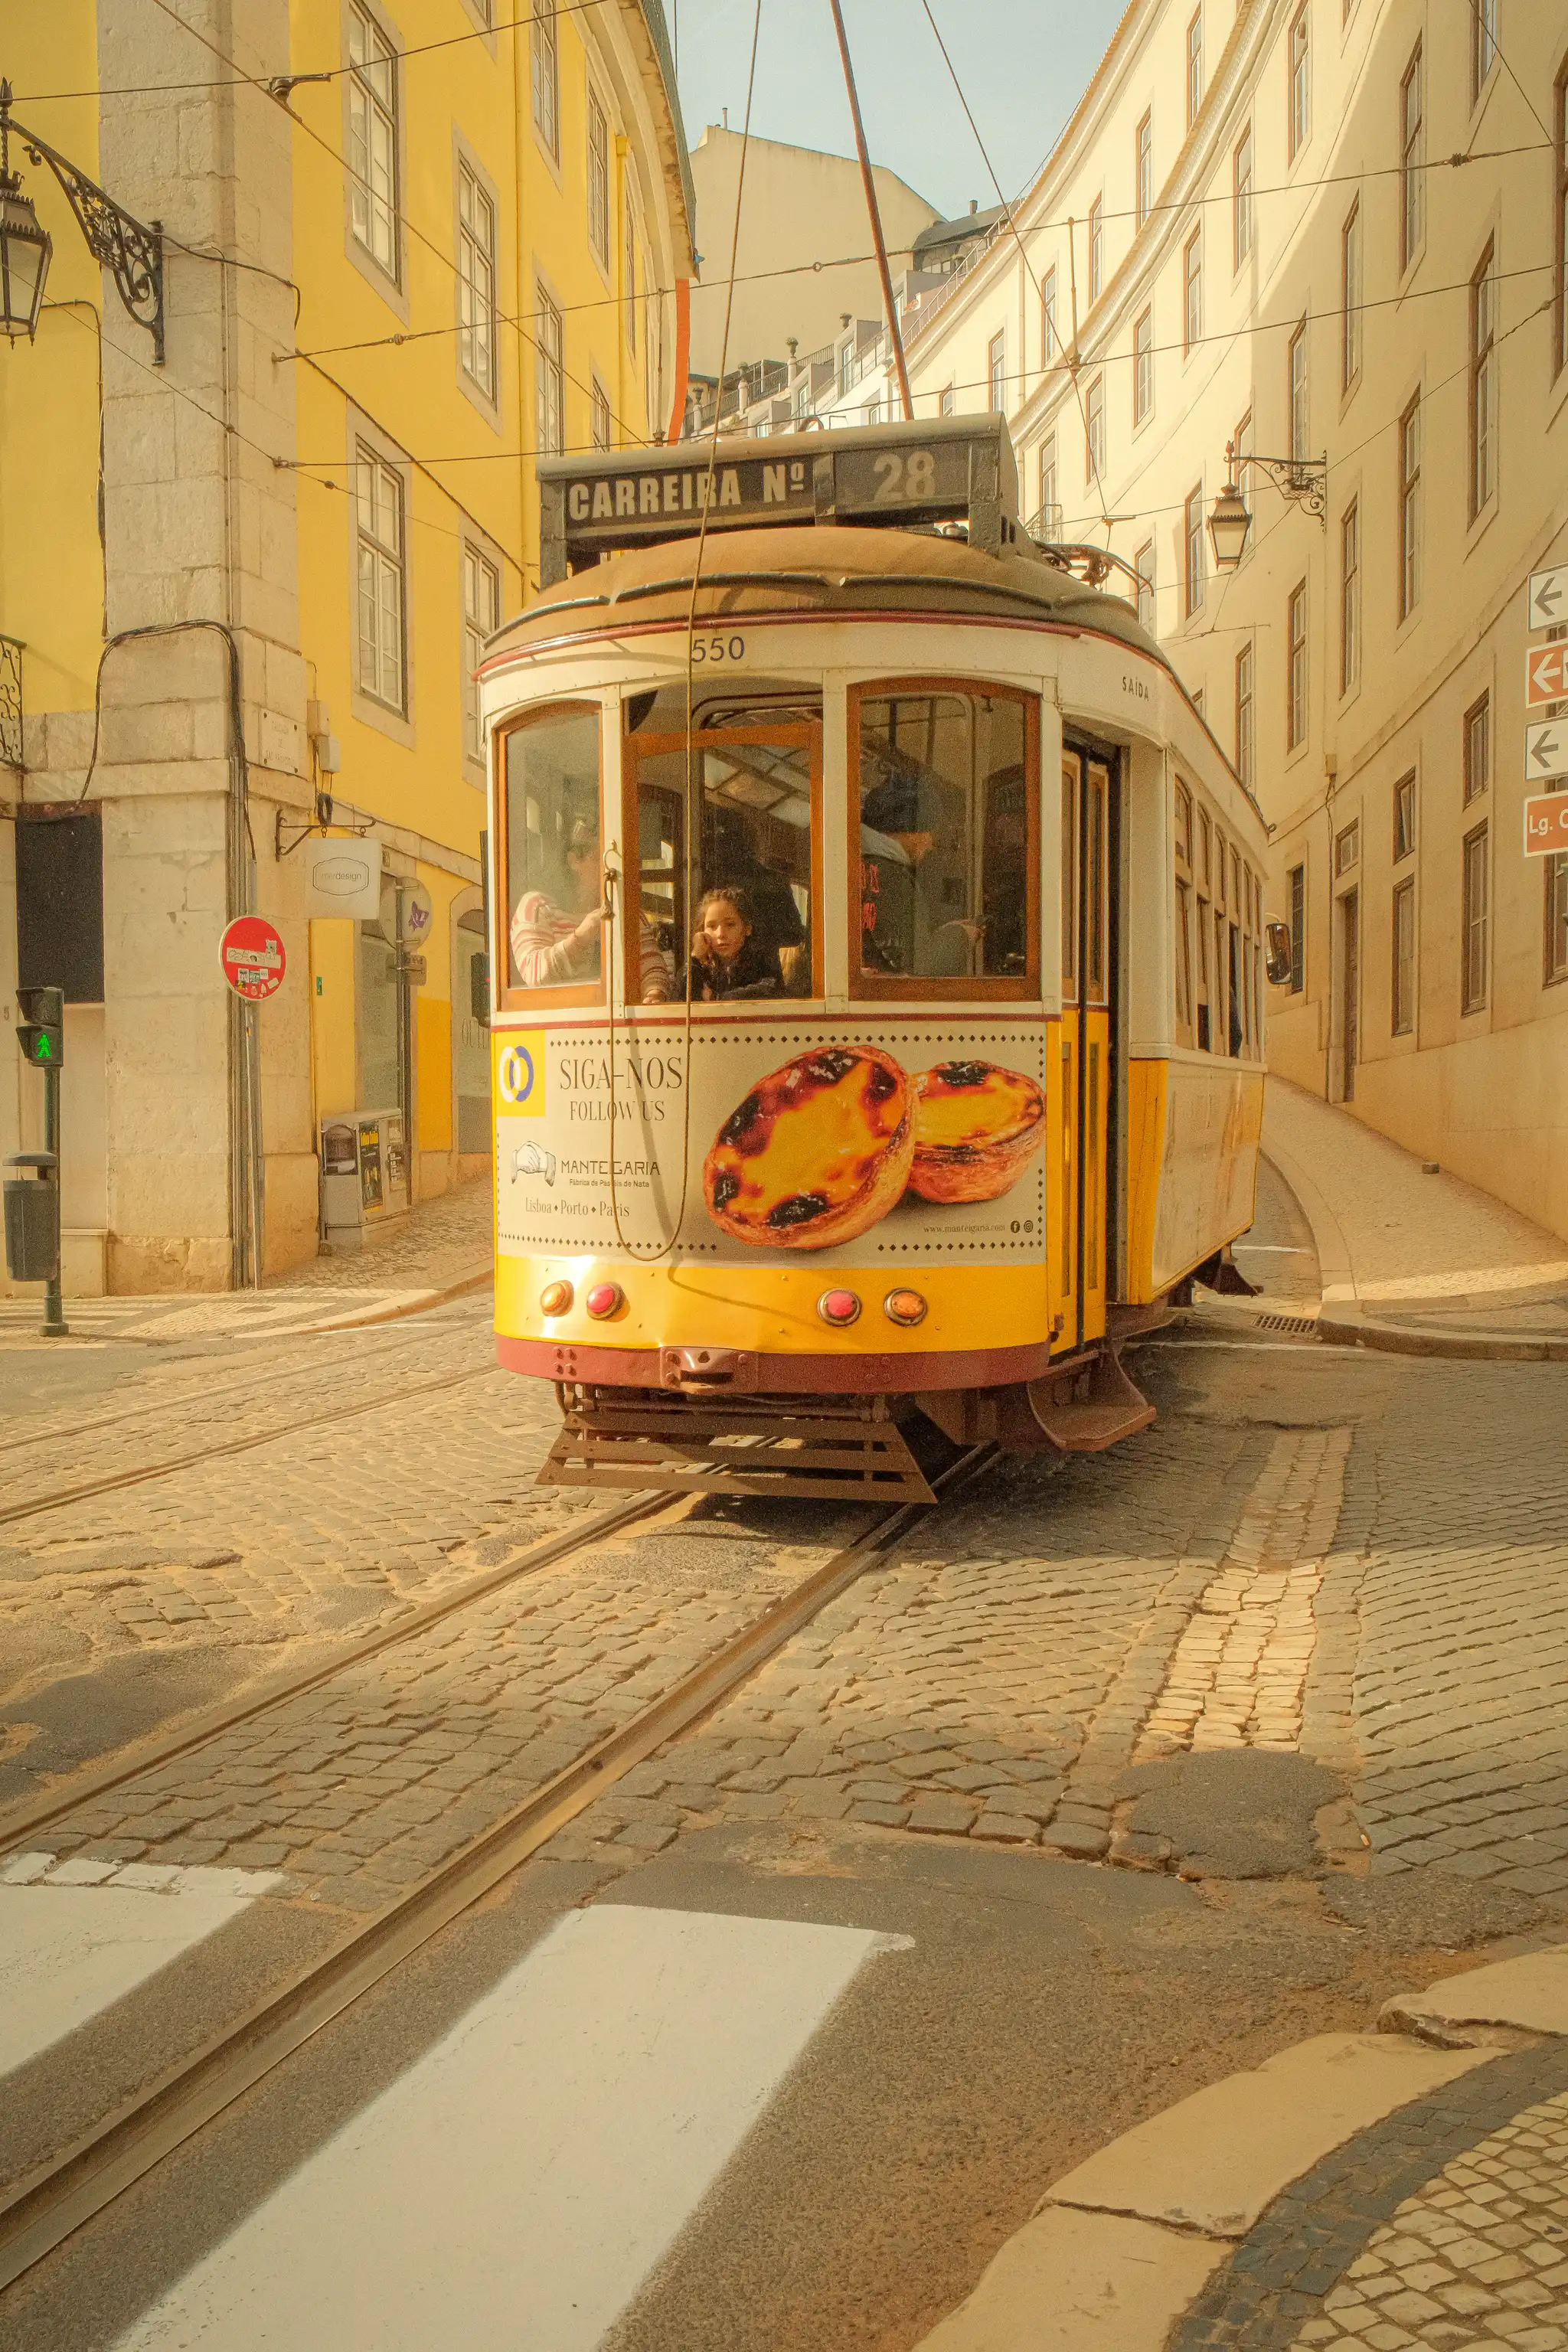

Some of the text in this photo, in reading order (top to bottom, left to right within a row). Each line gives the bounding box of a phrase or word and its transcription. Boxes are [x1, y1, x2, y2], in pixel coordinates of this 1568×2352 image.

[569, 450, 936, 521] CARREIRA Nº 28
[691, 635, 746, 663] 550
[1529, 815, 1553, 836] Lg.
[560, 1057, 683, 1090] SIGA-NOS
[570, 1100, 665, 1122] FOLLOW US
[560, 1160, 661, 1176] MANTEGARIA
[525, 1197, 552, 1214] Lisboa
[560, 1199, 589, 1216] Porto
